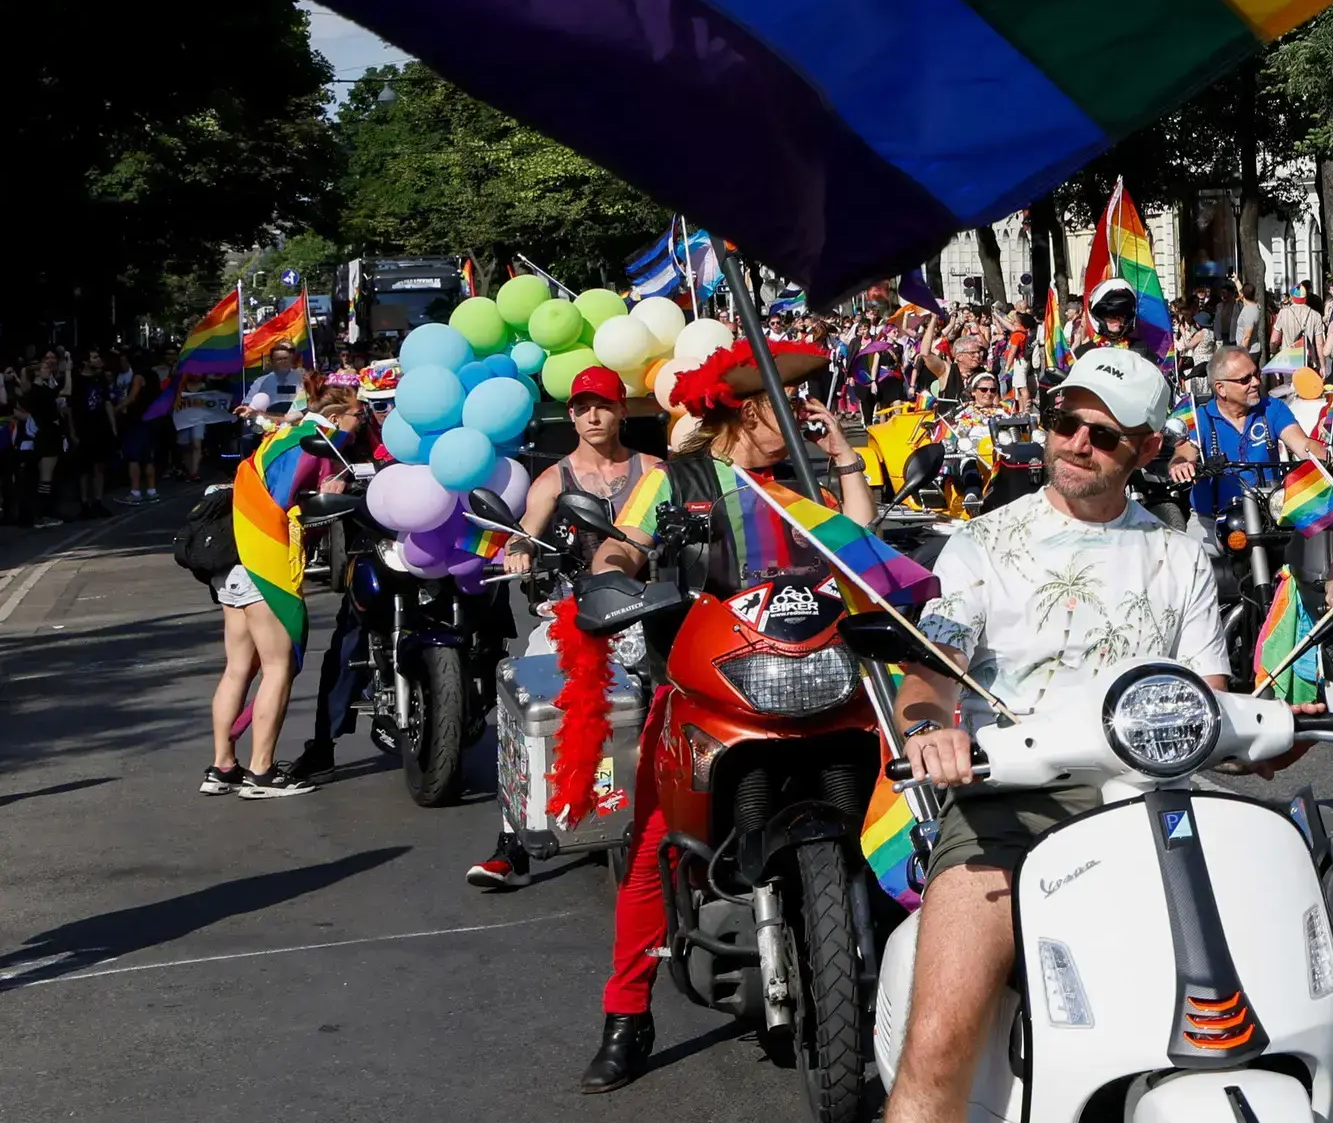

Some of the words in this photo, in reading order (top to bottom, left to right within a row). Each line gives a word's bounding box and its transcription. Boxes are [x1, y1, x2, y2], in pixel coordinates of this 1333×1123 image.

[610, 601, 644, 617] TOURATECH
[769, 601, 819, 614] BIKER
[1166, 814, 1179, 831] P
[1039, 858, 1102, 900] Vespa
